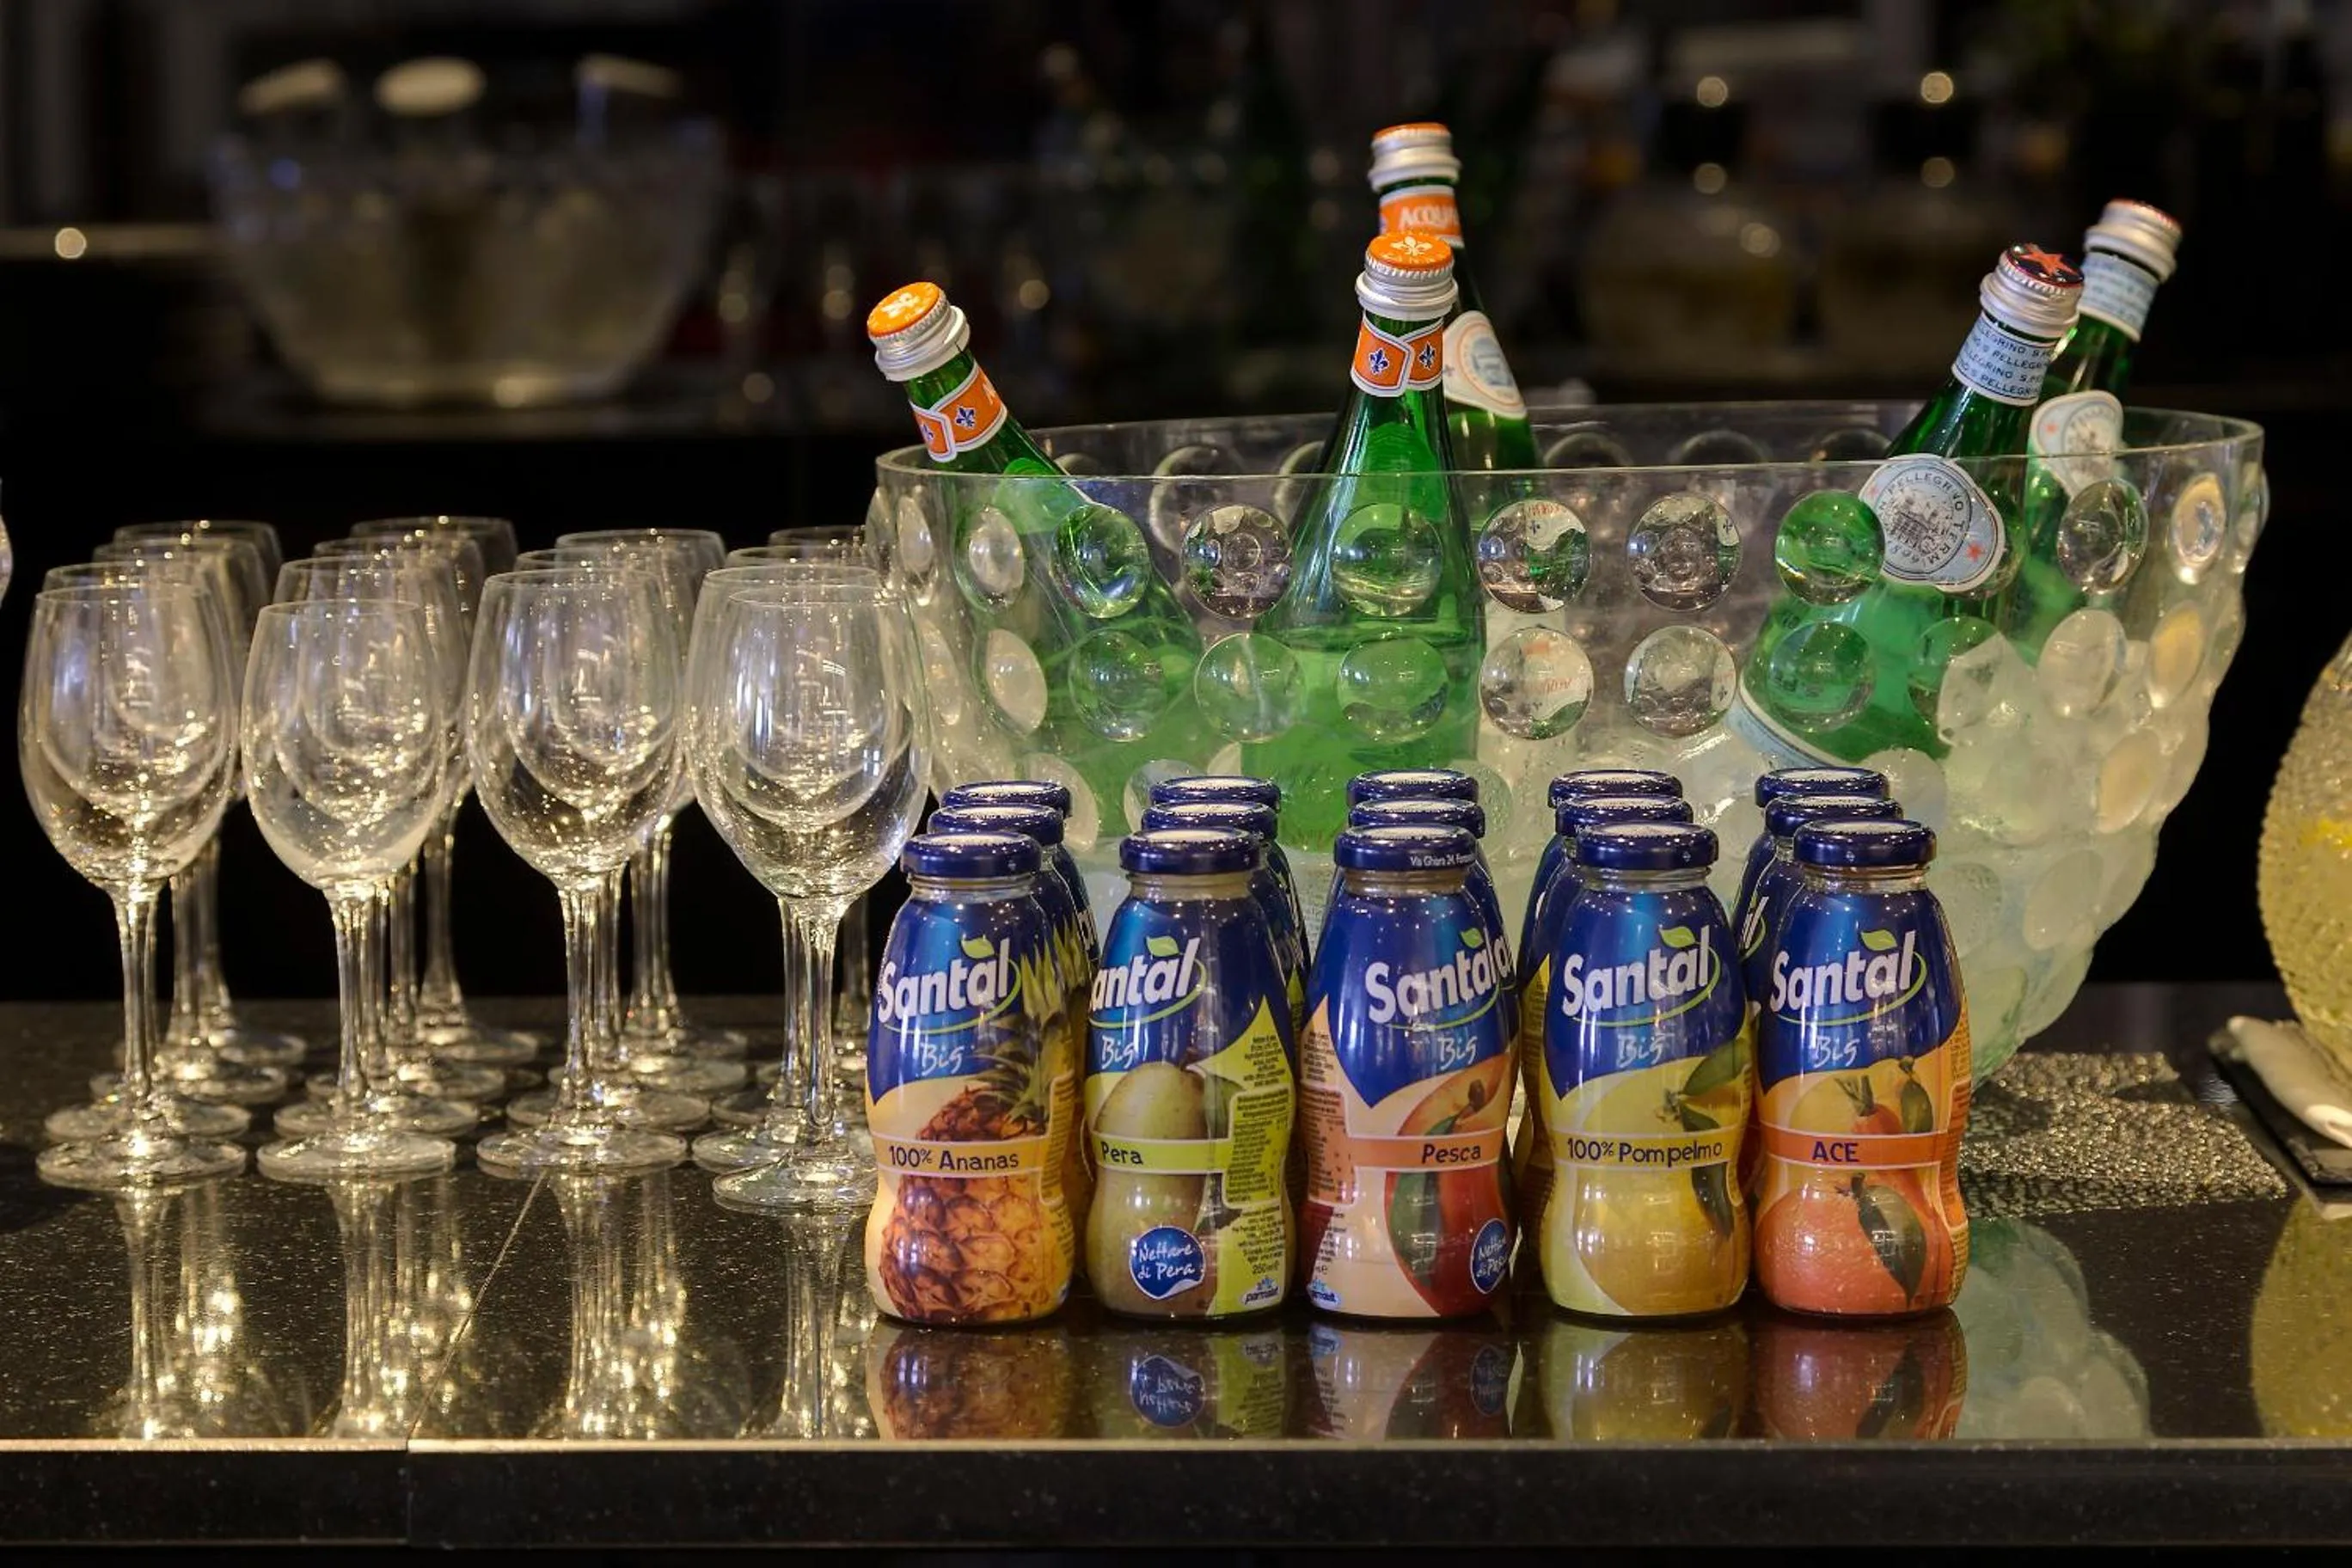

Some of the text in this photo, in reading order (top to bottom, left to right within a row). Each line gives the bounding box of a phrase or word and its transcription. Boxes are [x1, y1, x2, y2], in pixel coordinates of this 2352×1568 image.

[1091, 936, 1201, 1012] antal
[920, 1041, 965, 1076] Big
[1438, 1034, 1478, 1069] Big
[1813, 1035, 1860, 1069] Big
[889, 1145, 1020, 1171] 100% Ananas
[1100, 1141, 1143, 1165] Pera
[1421, 1143, 1481, 1164] Pesca
[1567, 1137, 1723, 1168] 100% Pompelmo
[1811, 1141, 1859, 1163] ACE
[1139, 1241, 1193, 1263] Nettare
[1155, 1262, 1196, 1281] Pera
